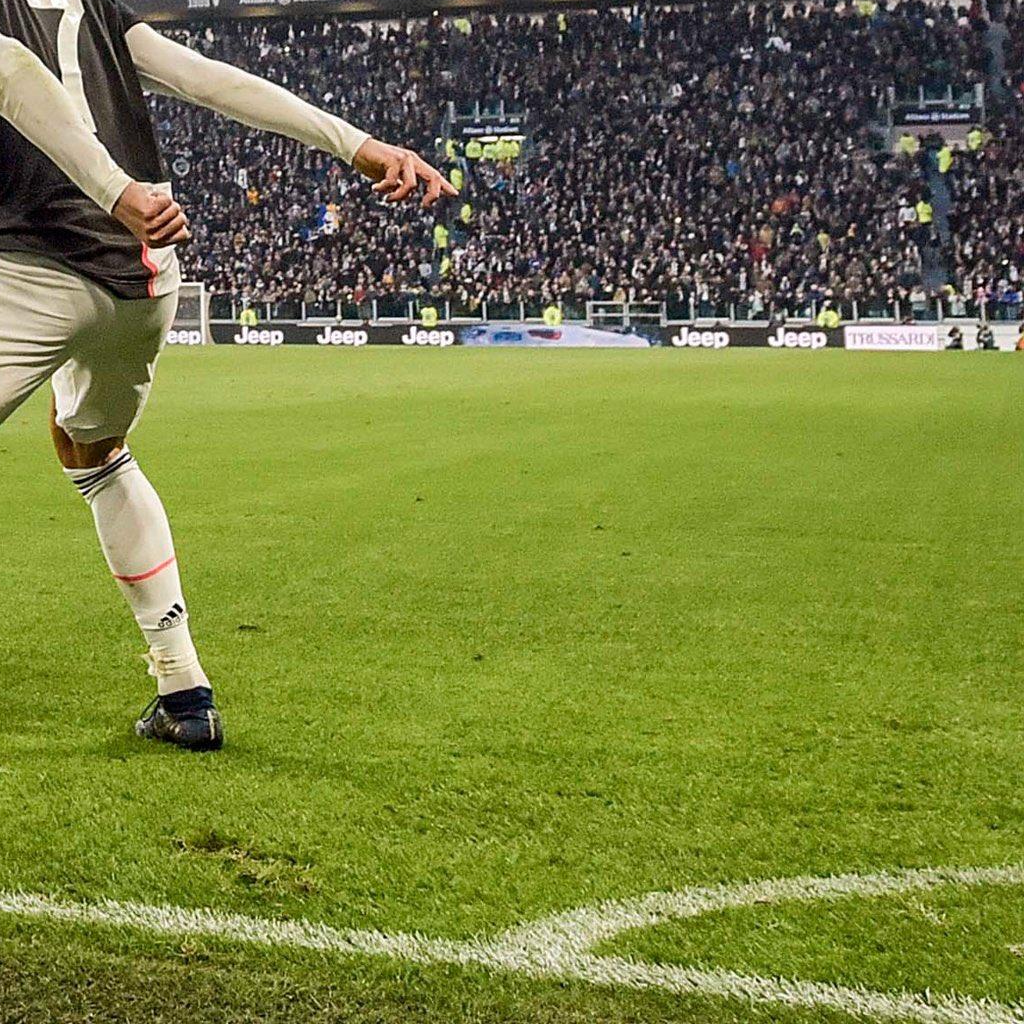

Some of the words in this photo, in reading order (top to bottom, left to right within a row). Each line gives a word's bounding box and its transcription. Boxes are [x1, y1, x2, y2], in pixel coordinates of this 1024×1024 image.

[166, 327, 202, 346] eep
[234, 325, 284, 347] Jeep
[316, 325, 368, 347] Jeep
[402, 325, 454, 347] Jeep
[672, 326, 729, 349] Jeep
[768, 326, 827, 350] Jeep
[848, 332, 935, 346] TRUSSARDI
